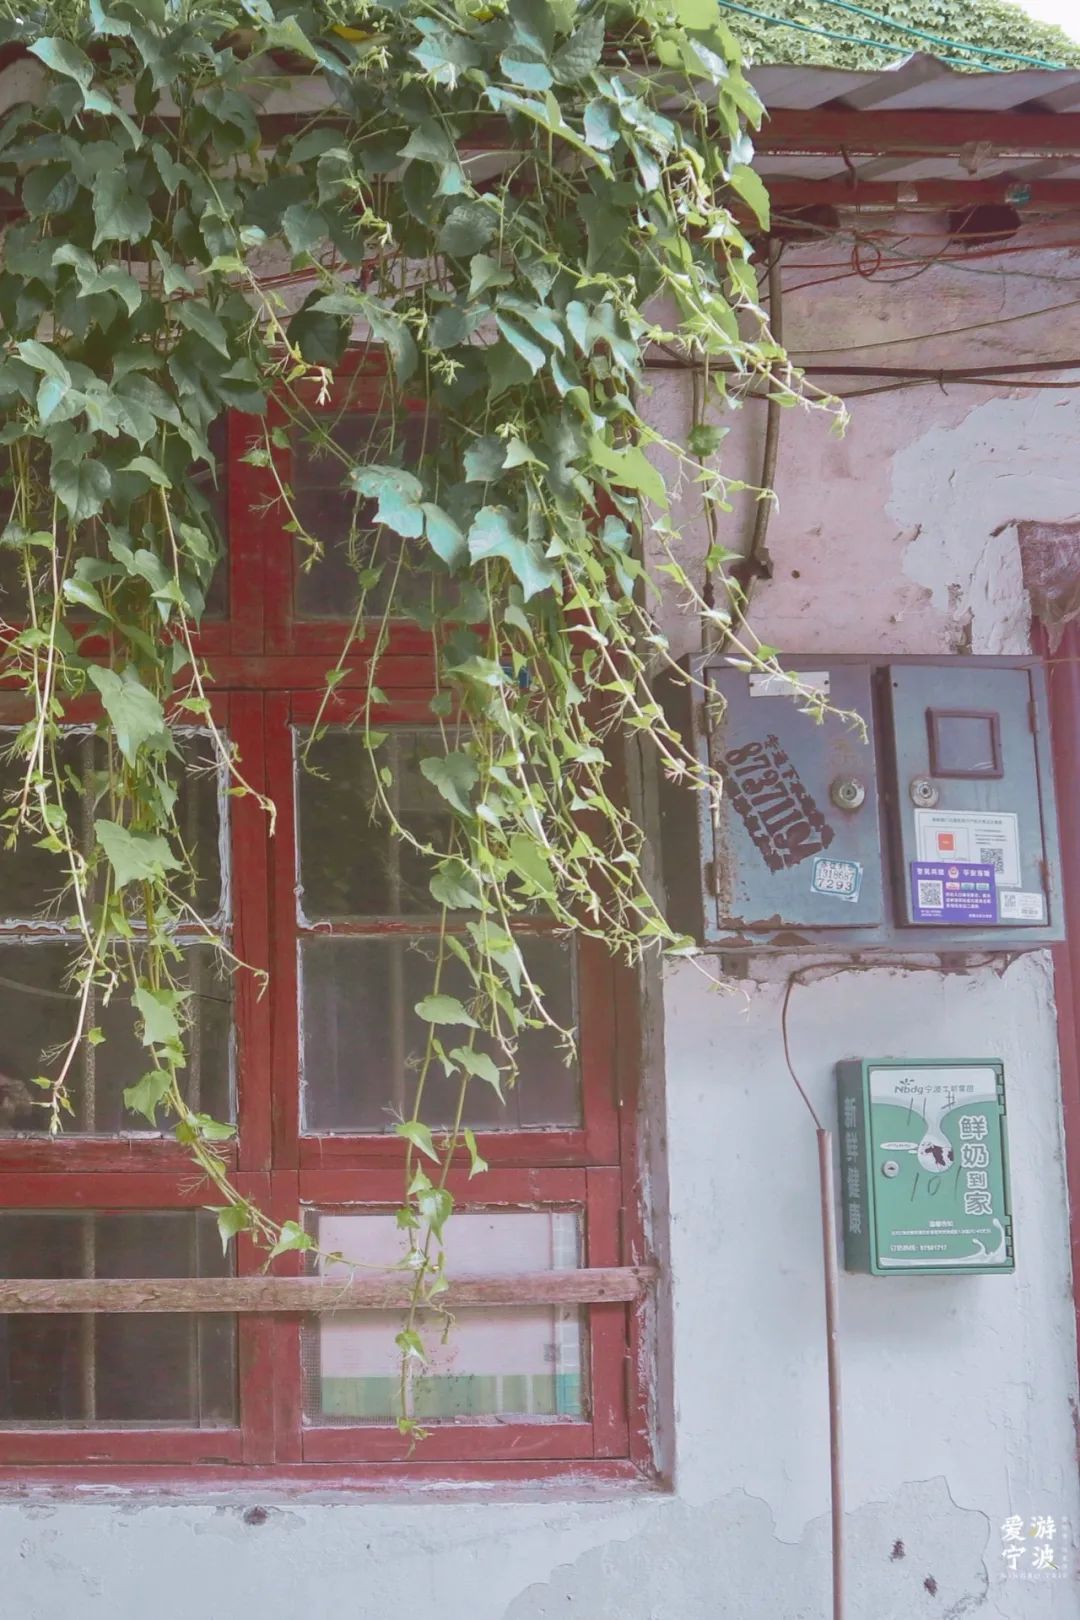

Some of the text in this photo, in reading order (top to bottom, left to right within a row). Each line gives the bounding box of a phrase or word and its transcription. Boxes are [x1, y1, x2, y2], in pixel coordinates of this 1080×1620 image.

[817, 879, 852, 891] 7293
[959, 1115, 992, 1215] 鲜奶到家
